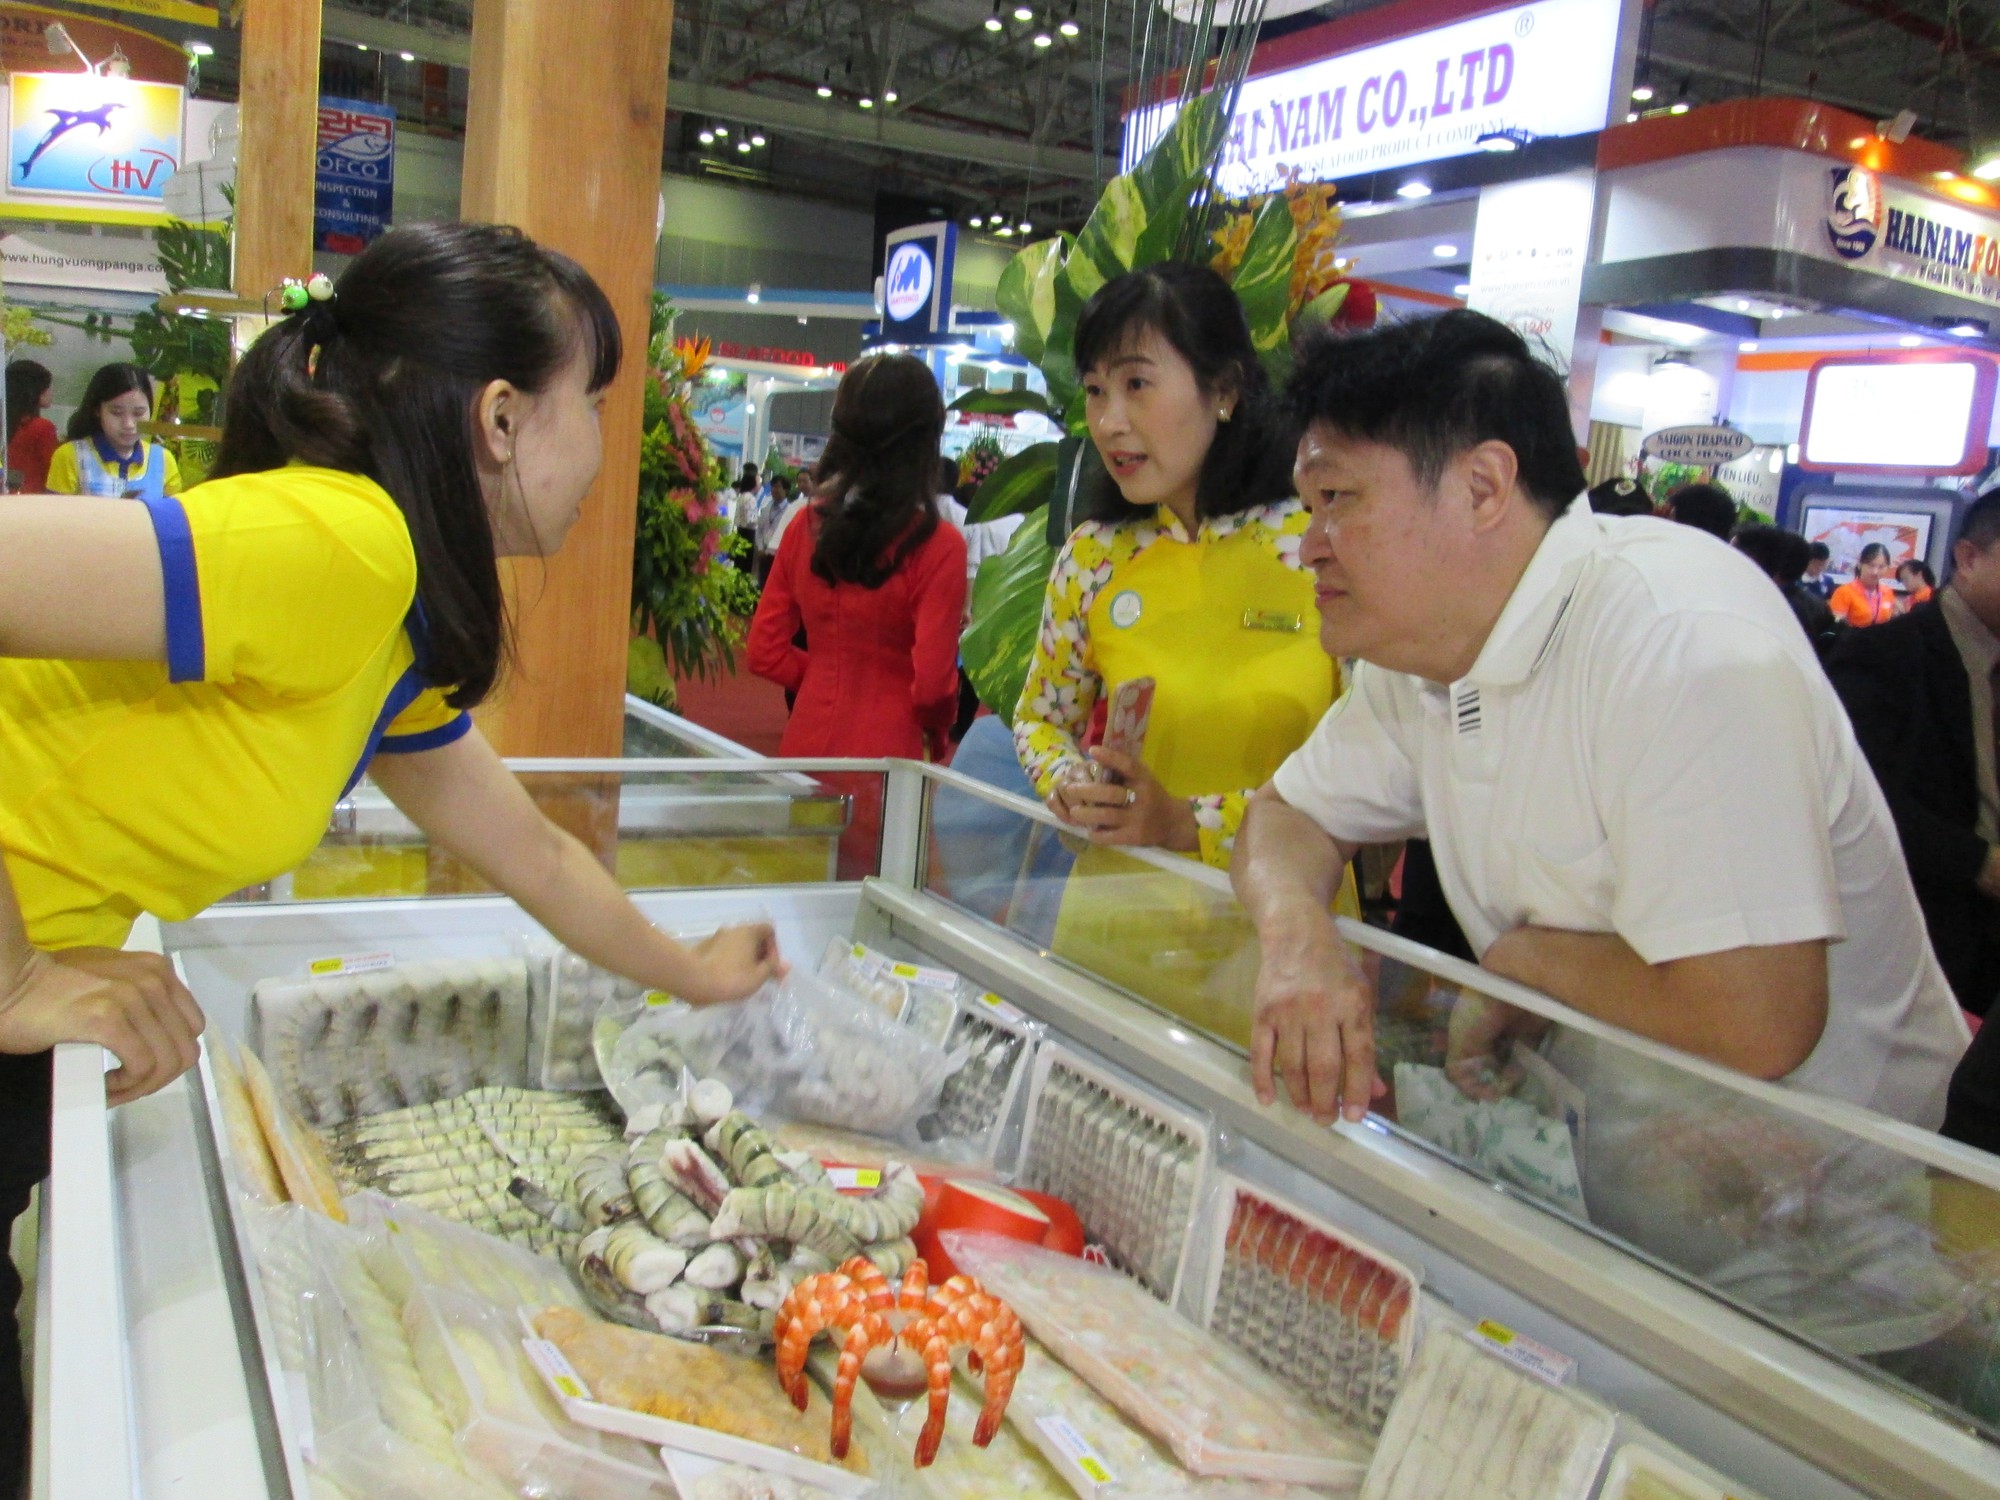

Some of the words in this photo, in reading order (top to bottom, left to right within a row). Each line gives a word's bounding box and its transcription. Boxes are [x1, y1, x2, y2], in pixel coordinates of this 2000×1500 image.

[1268, 85, 1347, 156] NAM
[1356, 42, 1515, 136] CO.,LTD
[1314, 145, 1369, 173] SEAFOOD
[1371, 132, 1433, 160] PRODUCT
[1436, 116, 1508, 146] COMPANY
[316, 180, 378, 200] INSPECTION
[342, 197, 351, 208] &
[1885, 207, 2000, 280] HAINAMFO
[0, 253, 165, 274] www.hungvuongpanga.co
[719, 342, 815, 368] SEAFOOD
[1657, 433, 1693, 446] SAIGON
